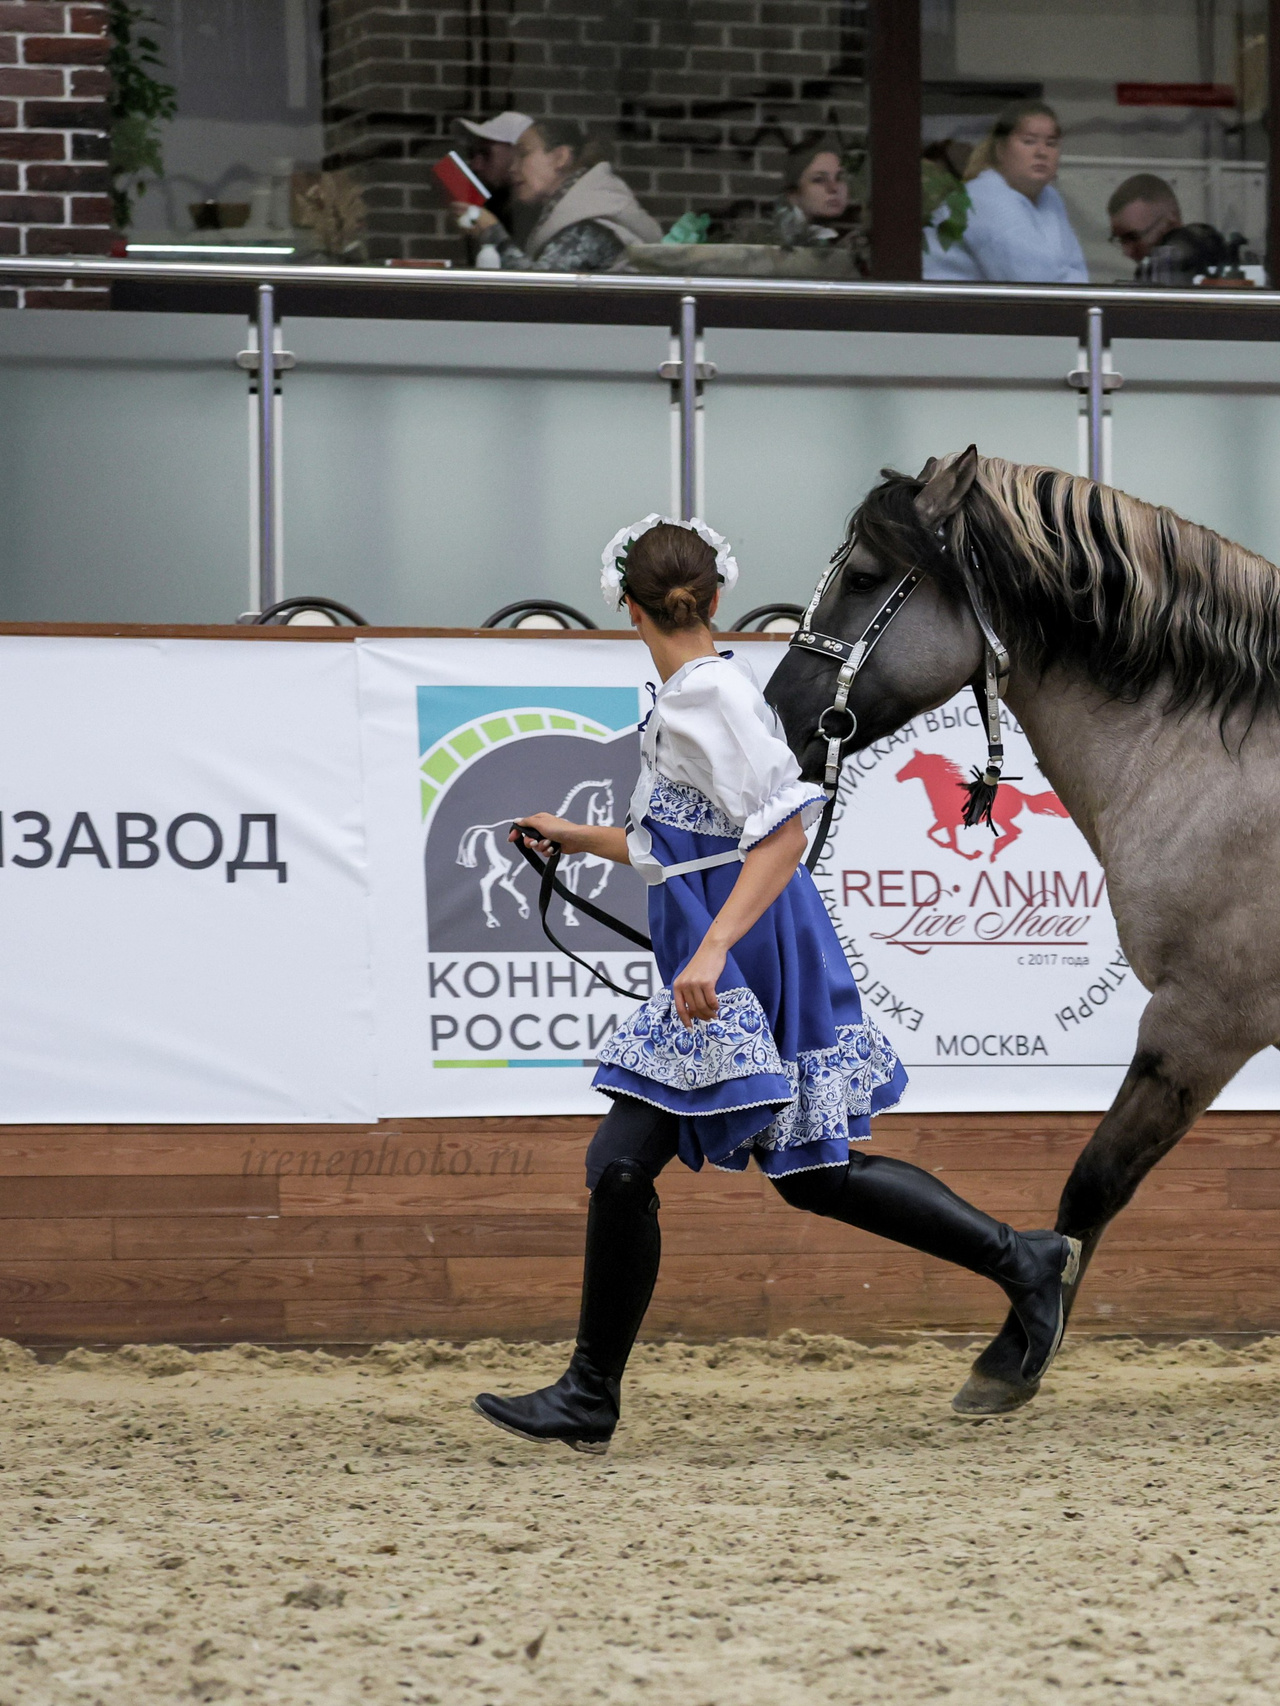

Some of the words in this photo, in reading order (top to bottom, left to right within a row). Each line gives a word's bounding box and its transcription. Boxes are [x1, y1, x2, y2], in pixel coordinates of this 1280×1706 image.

[869, 889, 967, 956] Live
[974, 889, 1092, 941] Show
[427, 960, 654, 999] КОННАЯ
[1027, 953, 1059, 966] 2017
[1061, 956, 1091, 968] года
[1054, 948, 1131, 1032] АТЮРЫ
[430, 1013, 619, 1052] РОССИ
[935, 1034, 1049, 1057] МОСКВА
